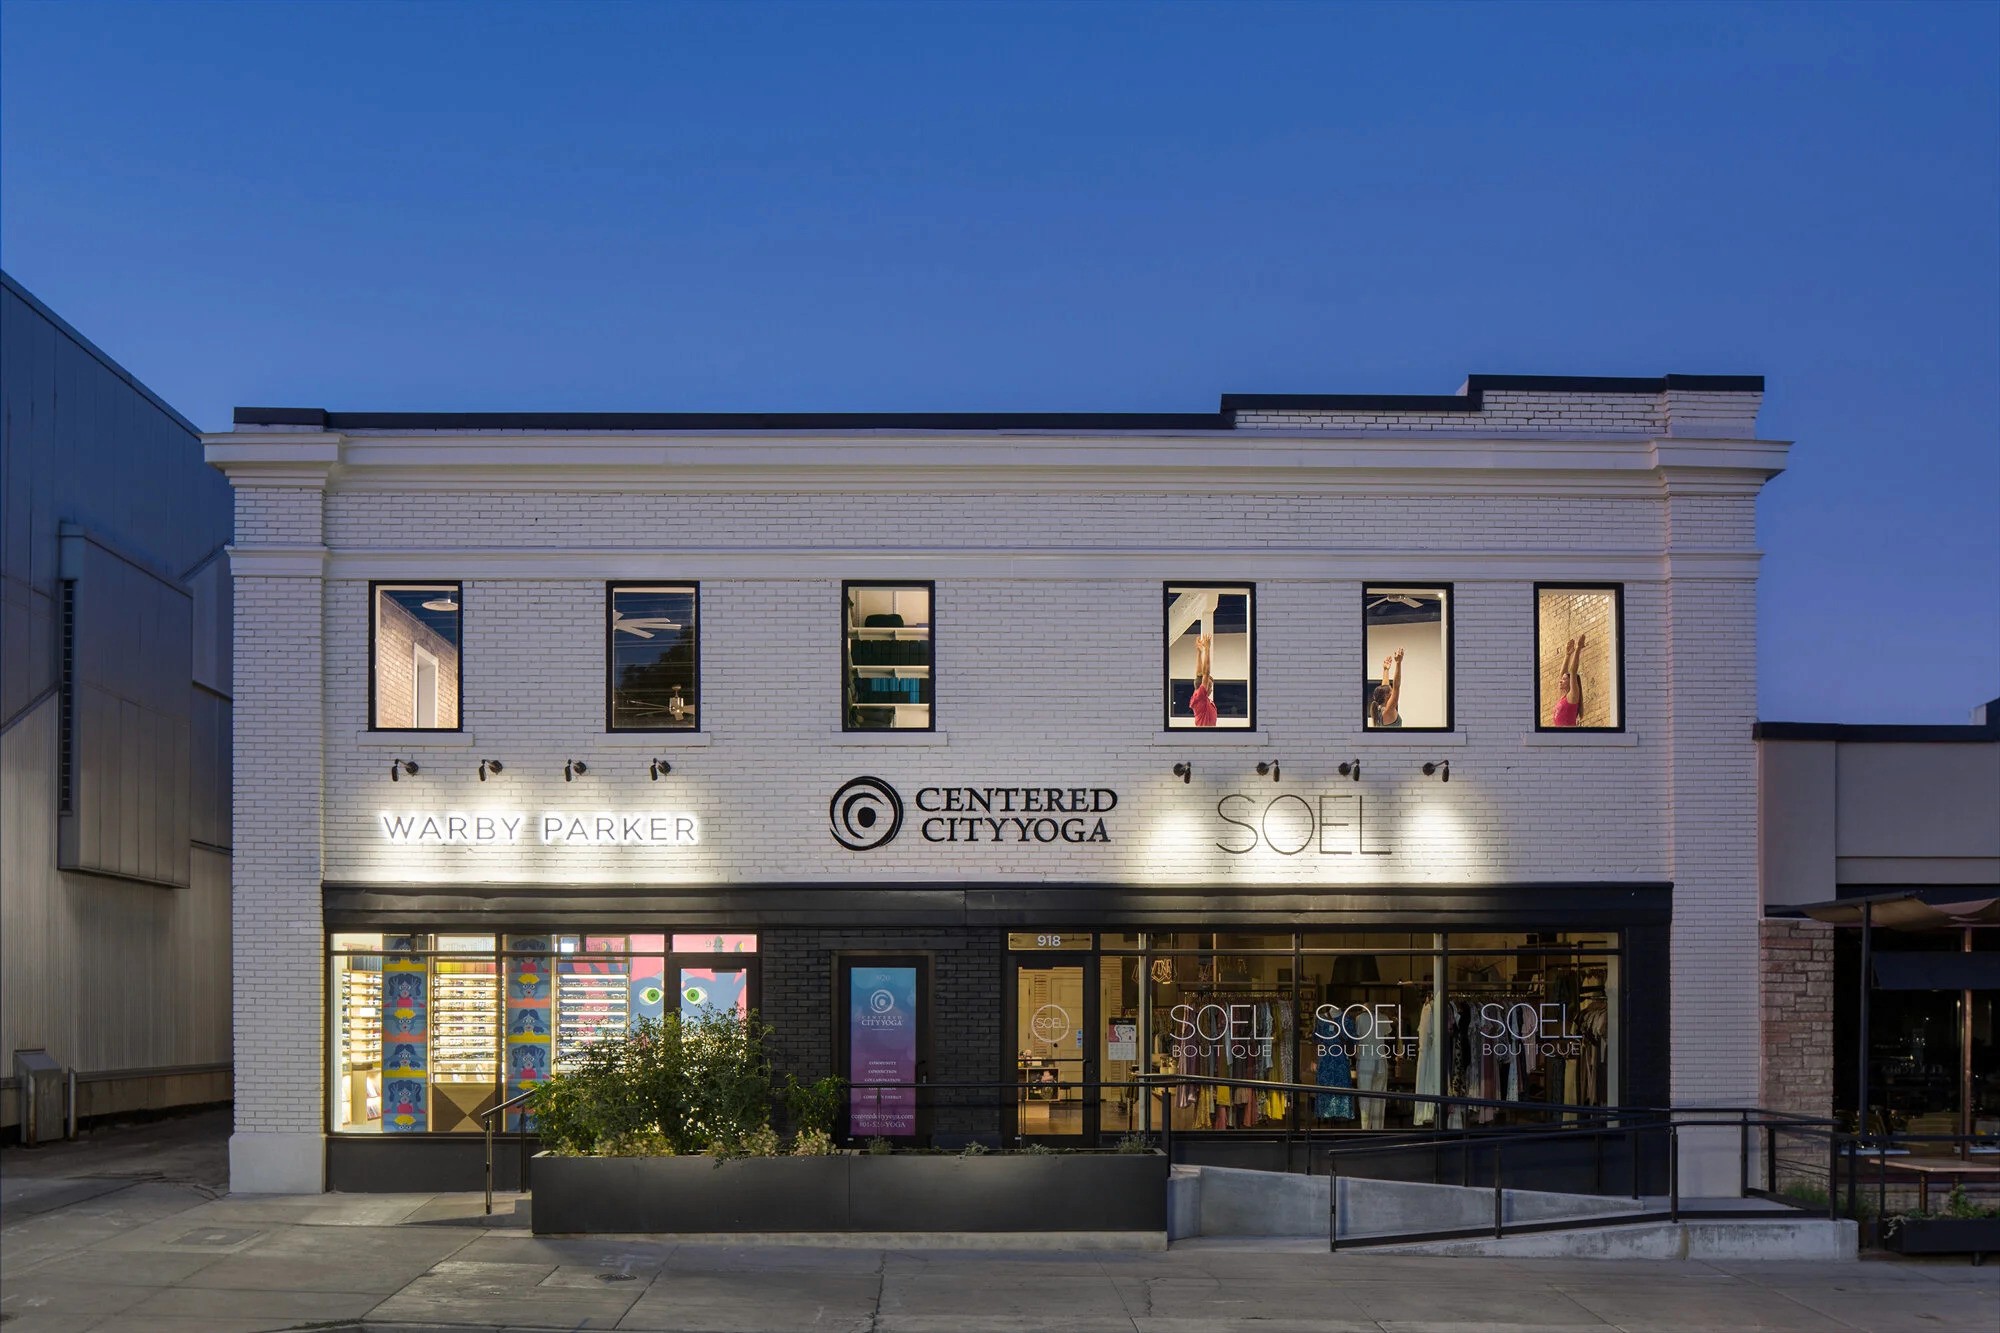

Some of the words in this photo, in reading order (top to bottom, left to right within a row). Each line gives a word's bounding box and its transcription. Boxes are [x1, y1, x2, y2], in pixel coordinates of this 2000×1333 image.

[915, 787, 1118, 814] CENTERED
[382, 815, 521, 841] WARBY
[544, 815, 696, 841] PARKER
[1215, 794, 1392, 855] SOEL
[1037, 935, 1061, 947] 918
[1036, 1017, 1066, 1029] SOEL
[1170, 1004, 1274, 1041] SOEL
[1315, 1003, 1419, 1041] SOEL
[1480, 1003, 1583, 1039] SOEL
[1317, 1044, 1416, 1059] BOUTIQUE
[1482, 1043, 1581, 1058] BOUTIQUE
